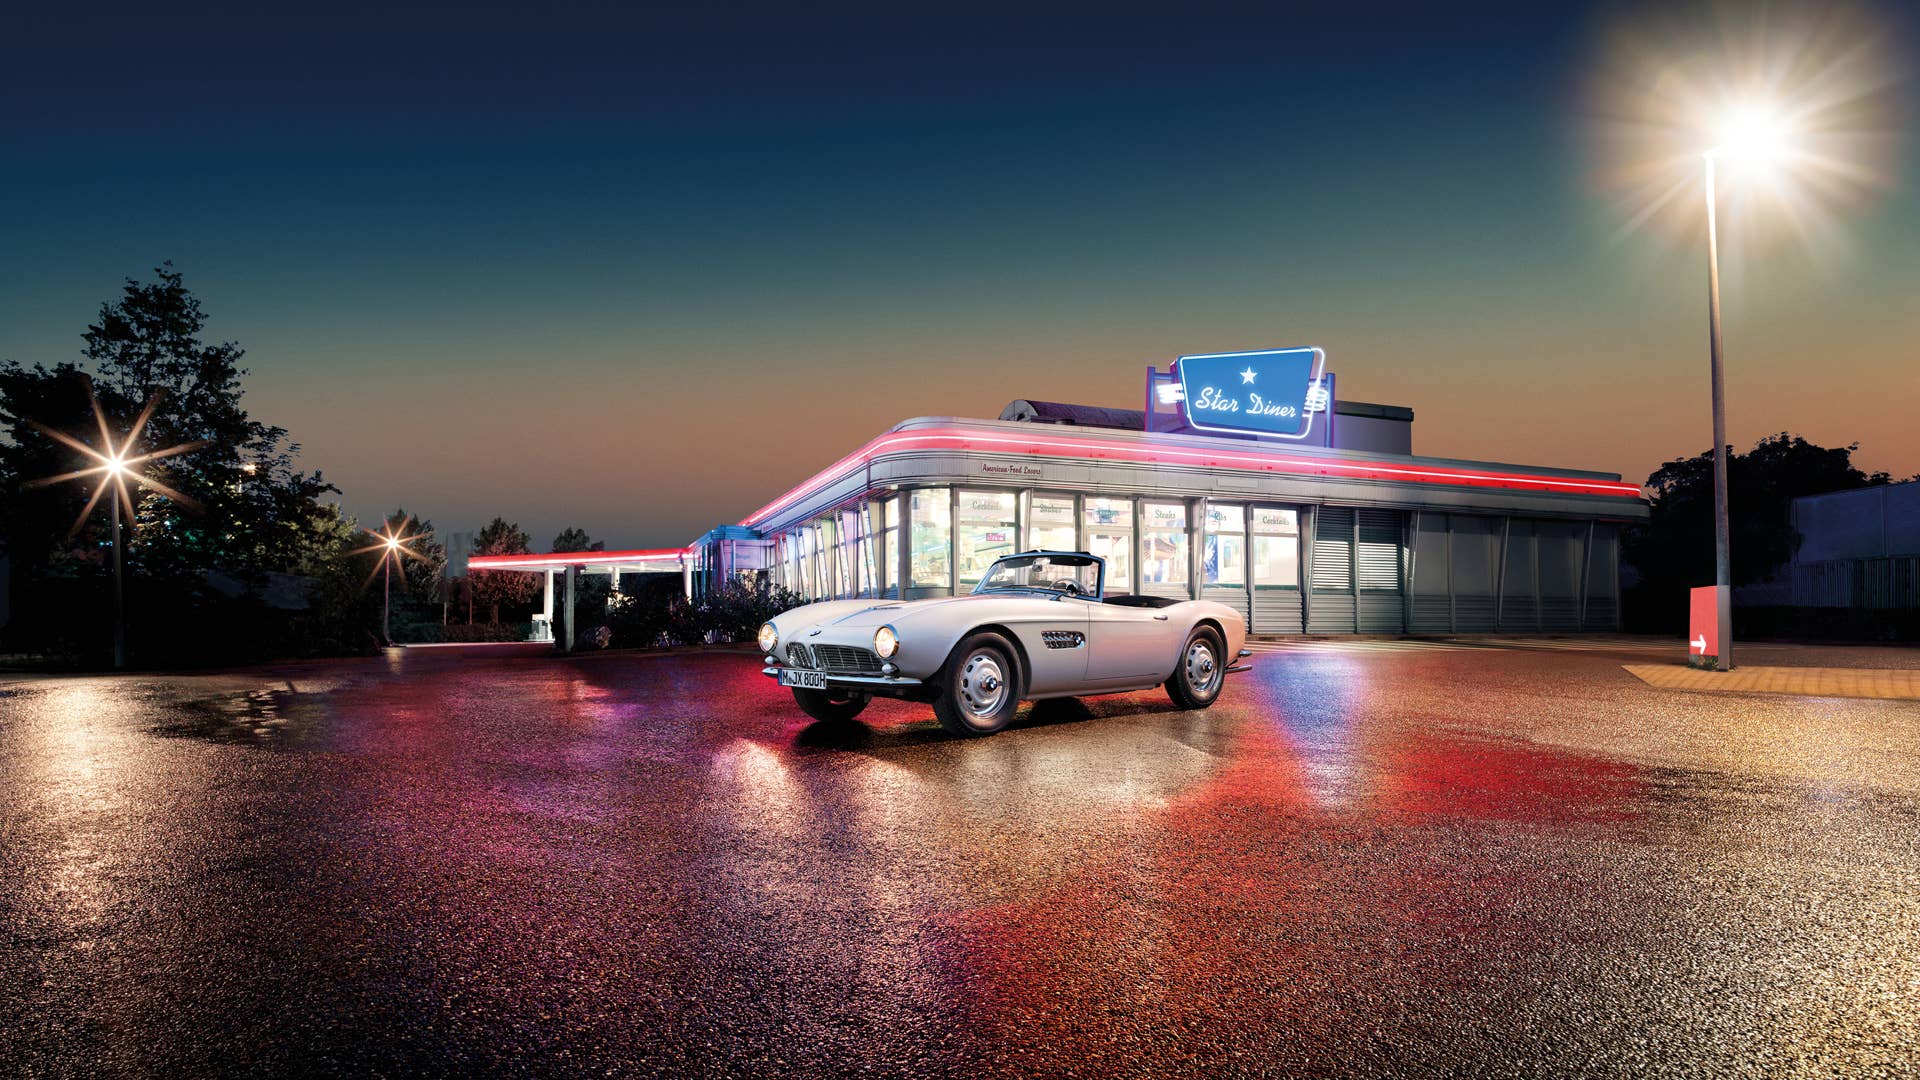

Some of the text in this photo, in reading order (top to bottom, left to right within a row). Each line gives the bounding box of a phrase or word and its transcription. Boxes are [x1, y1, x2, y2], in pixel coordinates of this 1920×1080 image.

[1195, 387, 1297, 418] Star Diner
[1154, 508, 1176, 519] Steaks
[804, 672, 826, 688] 800H
